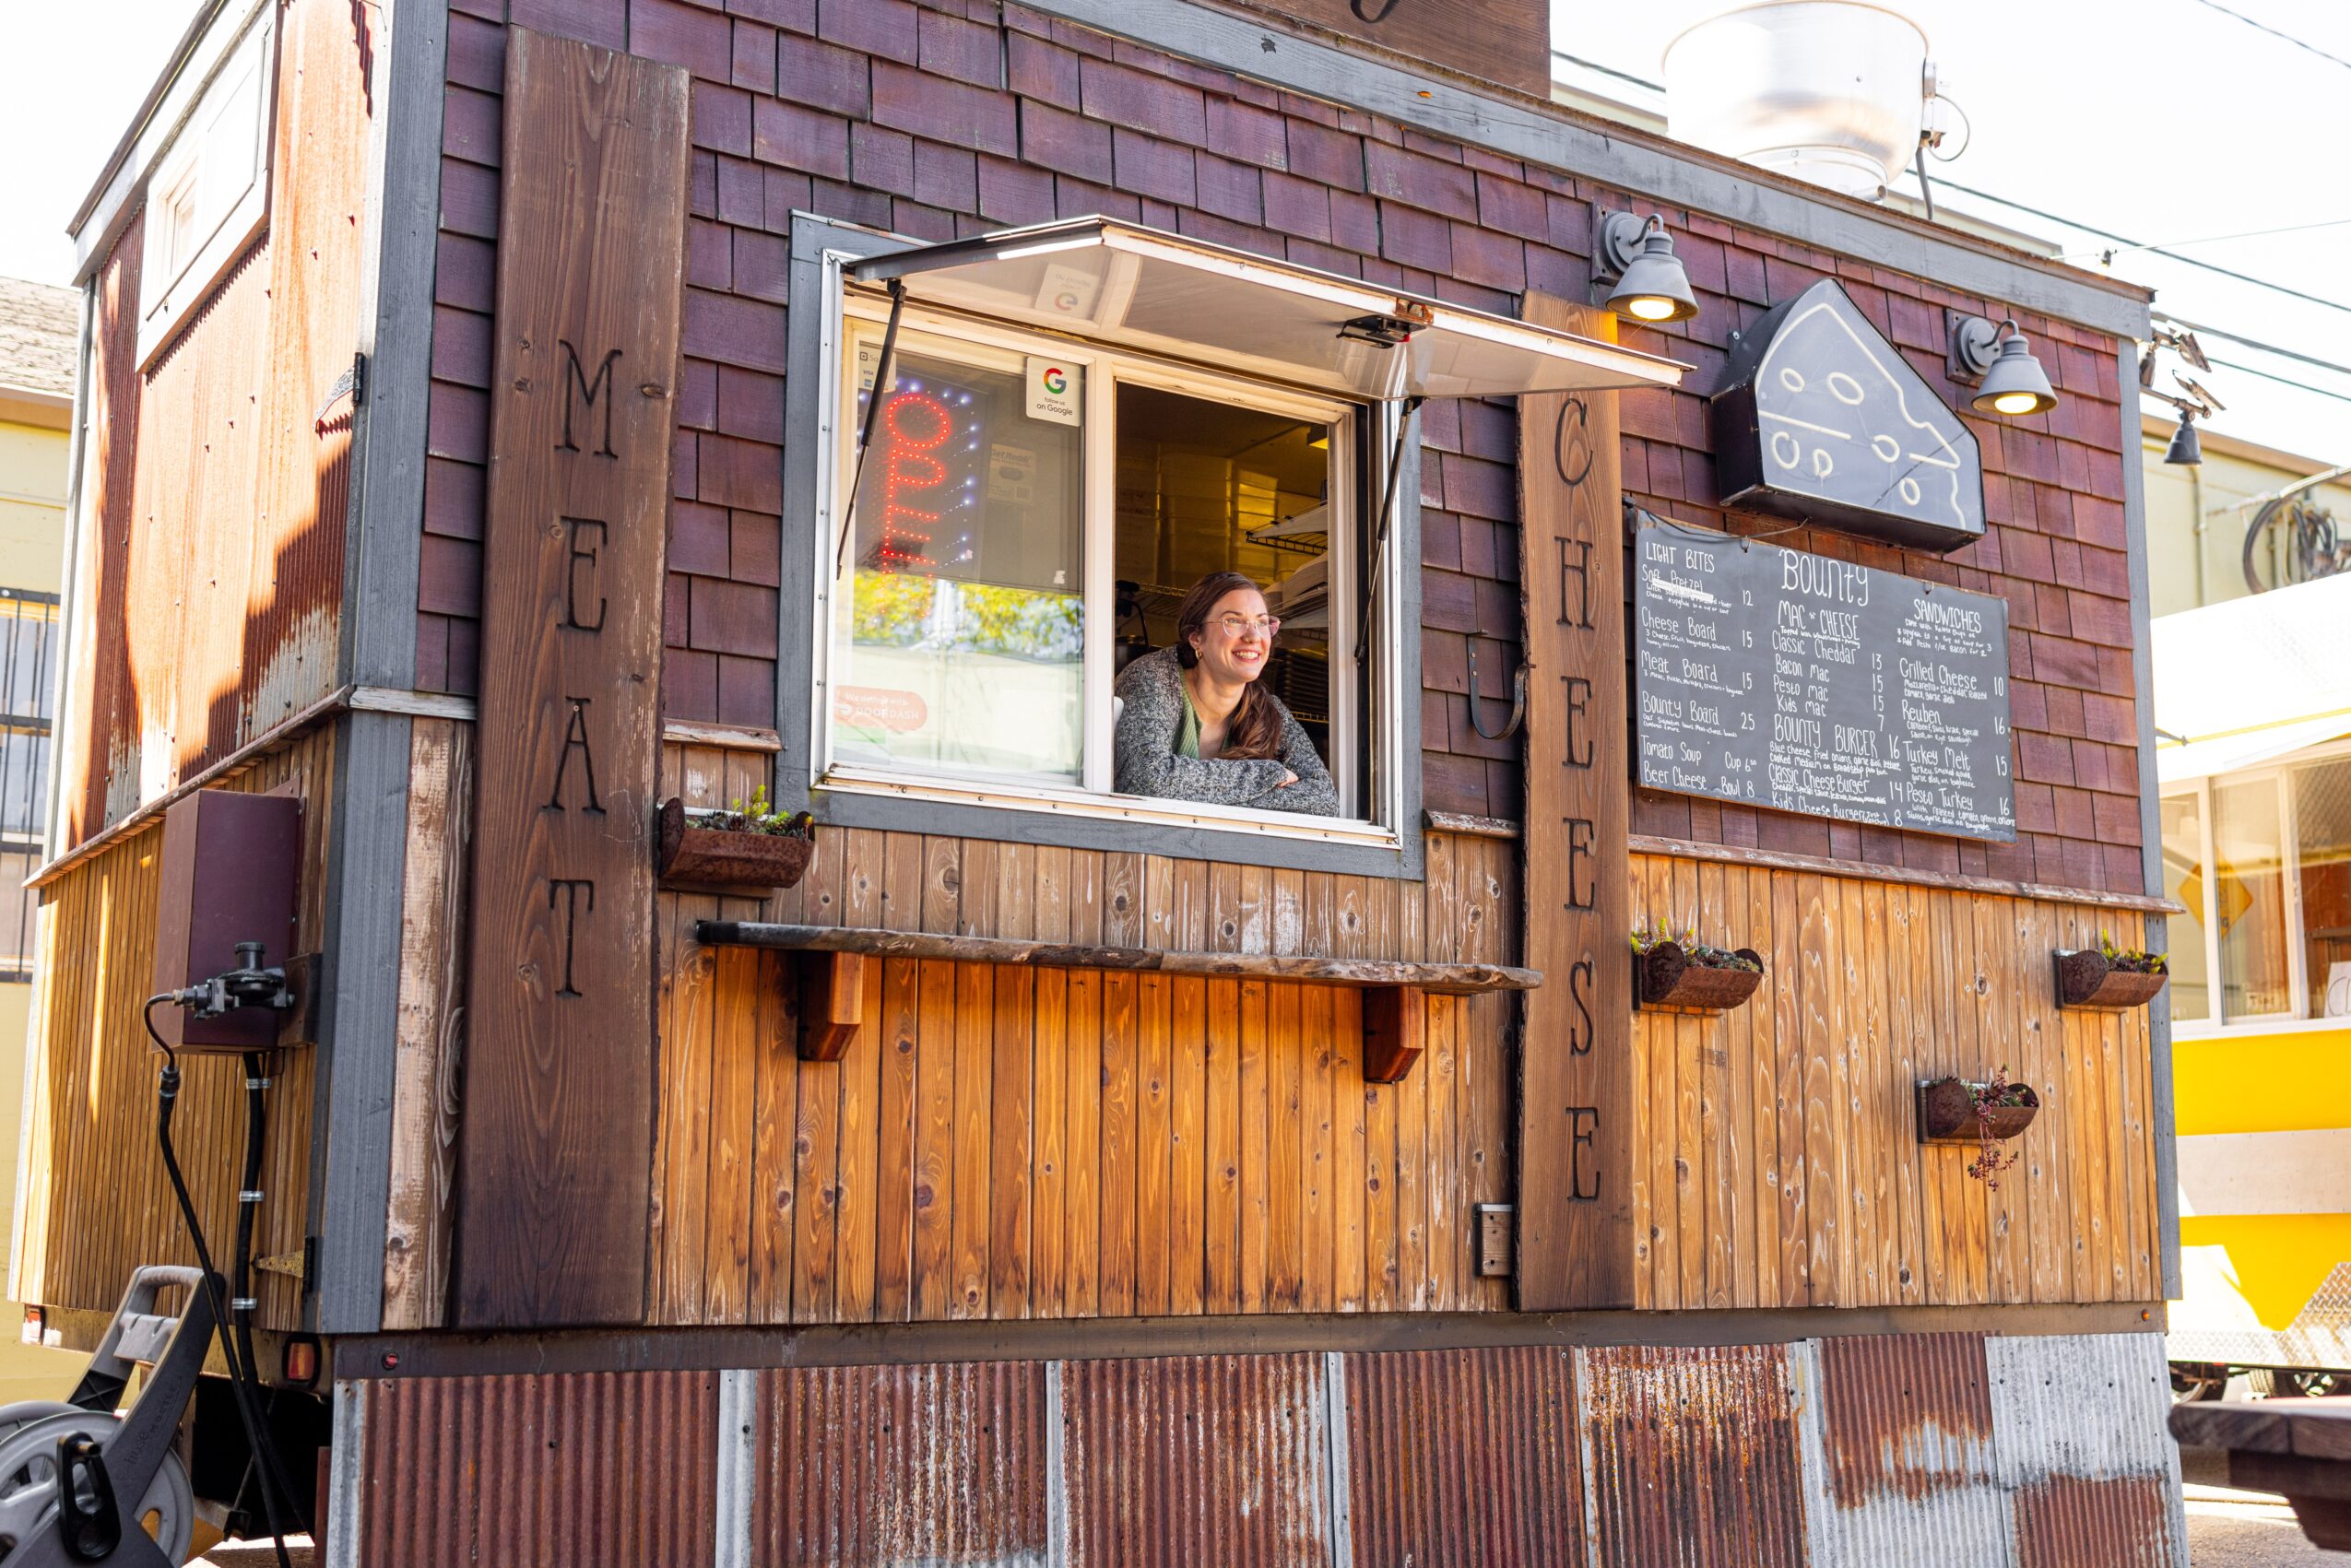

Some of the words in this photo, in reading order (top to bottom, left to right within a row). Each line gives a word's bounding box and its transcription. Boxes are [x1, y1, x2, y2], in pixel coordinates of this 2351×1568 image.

[1047, 404, 1073, 417] Google
[1647, 541, 1676, 564] LIGHT
[1685, 548, 1715, 573] BITES
[1671, 570, 1704, 593] Pretzel
[1743, 590, 1754, 607] 12
[1641, 606, 1678, 633] Cheese
[1687, 617, 1717, 642] Board
[1743, 630, 1753, 648] 15
[1778, 600, 1807, 630] MAC
[1820, 609, 1861, 641] CHEESE
[1913, 598, 1982, 634] SANDWICHES
[541, 336, 621, 997] MEAT
[1772, 630, 1805, 655] Classic
[1814, 638, 1857, 665] Cheddar
[1872, 653, 1883, 671] 13
[1987, 643, 1992, 653] 3
[1641, 650, 1669, 674] Meat
[1683, 658, 1719, 683] Board
[1743, 672, 1752, 690] 15
[1776, 654, 1803, 677] Bacon
[1872, 673, 1883, 693] 15
[1899, 657, 1934, 683] Grilled
[1938, 665, 1978, 690] Cheese
[1993, 677, 2004, 697] 10
[1642, 690, 1682, 719] Bounty
[1690, 701, 1720, 726] Board
[1741, 712, 1755, 730] 25
[1774, 674, 1800, 696] Pesto
[1873, 694, 1884, 712] 15
[1776, 693, 1798, 713] Kids
[1877, 713, 1884, 732] 7
[1901, 699, 1942, 725] Reuben
[1995, 716, 2005, 736] 16
[1641, 735, 1673, 760] Tomato
[1680, 741, 1702, 767] Soup
[1725, 751, 1741, 772] Cup
[1770, 741, 1785, 754] Blue
[1835, 725, 1878, 760] BURGER
[1888, 734, 1900, 760] 16
[1903, 741, 1938, 765] Turkey
[1945, 747, 1971, 771] Melt
[1996, 755, 2008, 776] 15
[1644, 760, 1669, 784] Beer
[1672, 766, 1707, 791] Cheese
[1720, 776, 1741, 796] Bowl
[1746, 780, 1755, 798] 8
[1768, 763, 1799, 785] Classic
[1889, 781, 1903, 804] 14
[1554, 396, 1602, 1204] CHEESE
[1772, 791, 1794, 811] Kids
[1798, 796, 1831, 817] Cheese
[1894, 809, 1903, 827] 8
[1907, 782, 1933, 806] Pesto
[1938, 787, 1973, 811] Turkey
[1999, 796, 2010, 816] 16
